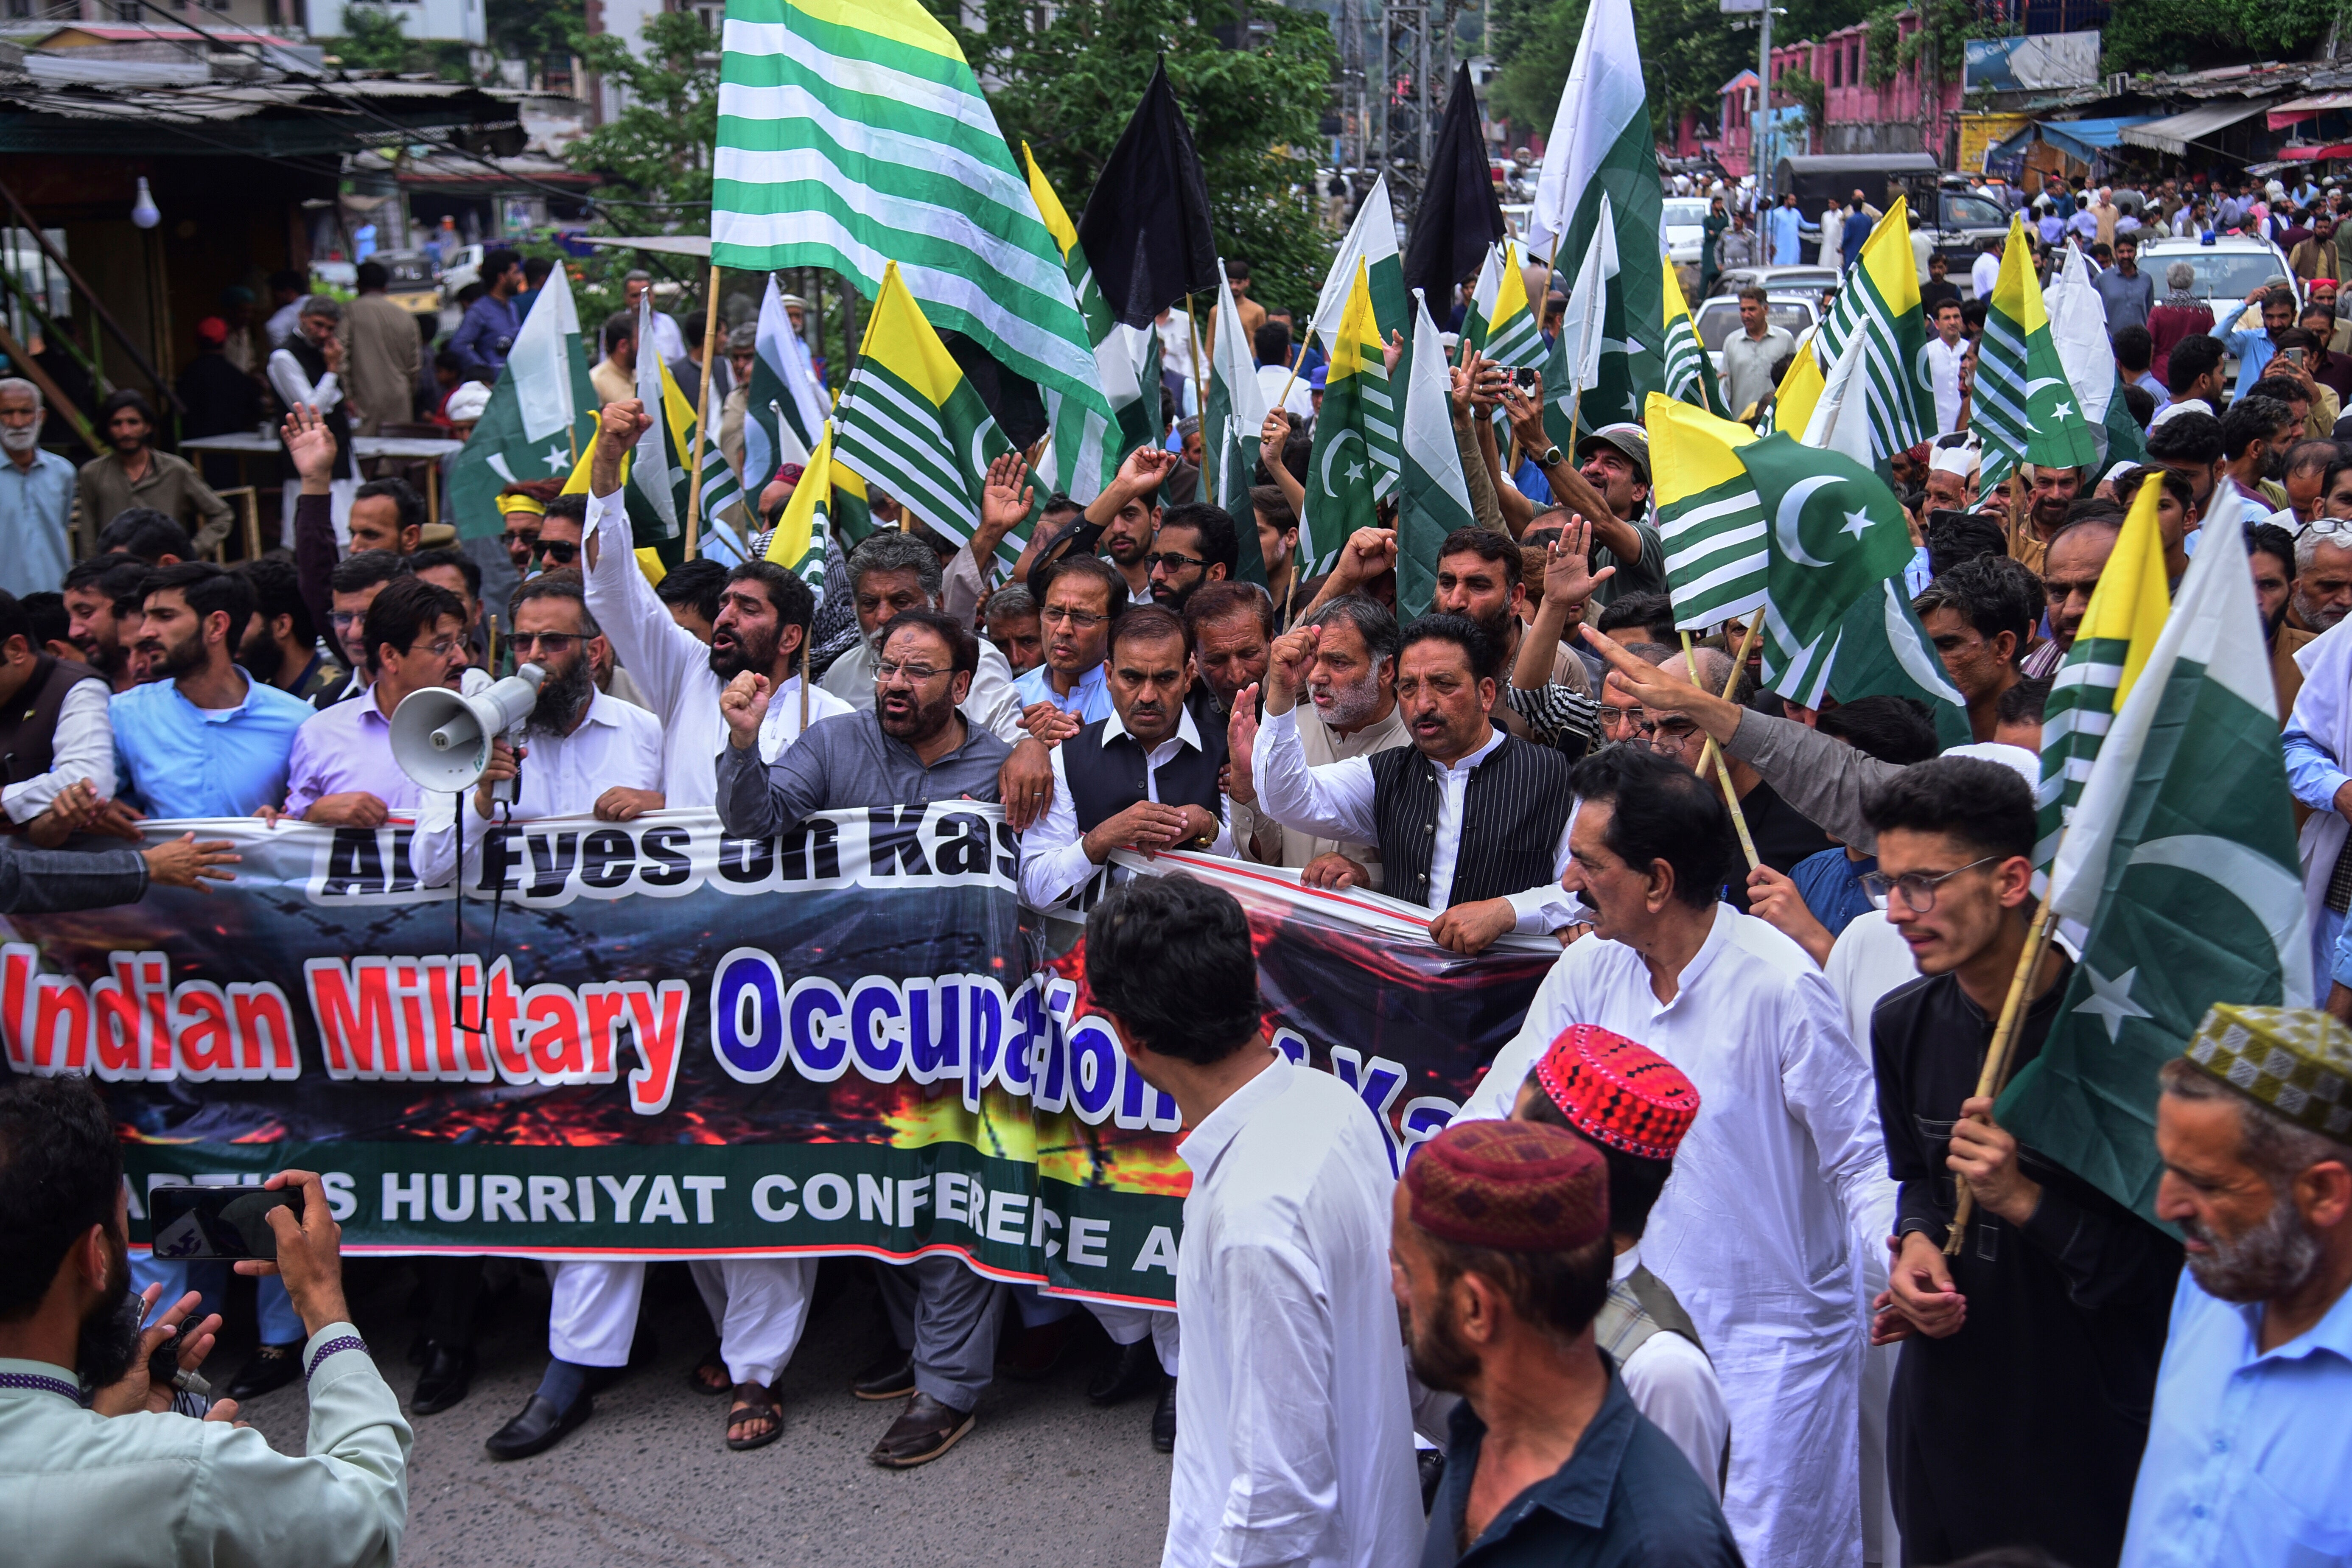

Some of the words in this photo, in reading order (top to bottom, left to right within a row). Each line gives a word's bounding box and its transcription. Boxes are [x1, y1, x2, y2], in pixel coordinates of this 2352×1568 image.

[321, 828, 451, 896] Al
[476, 825, 692, 899] Eyes
[717, 817, 841, 884] on
[2, 950, 295, 1073] Indian
[310, 962, 685, 1106] Military
[381, 1171, 727, 1224] HURRIYAT
